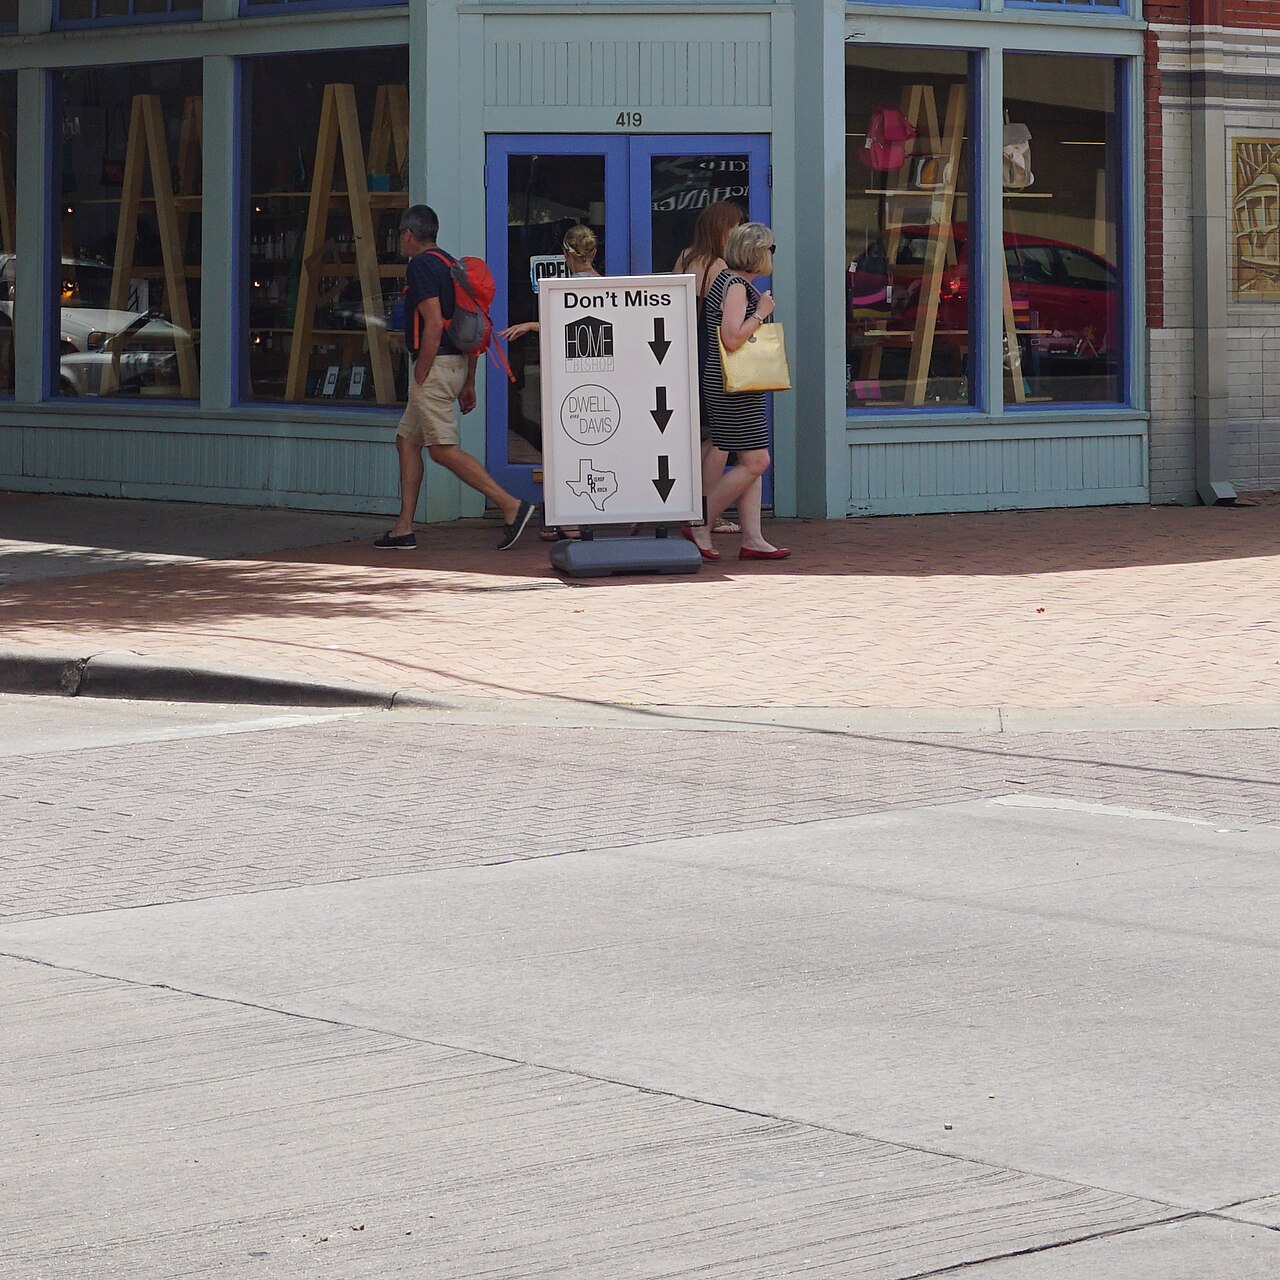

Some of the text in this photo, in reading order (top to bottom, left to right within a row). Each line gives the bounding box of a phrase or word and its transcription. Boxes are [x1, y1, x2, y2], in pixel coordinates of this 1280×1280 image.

[615, 111, 642, 127] 419
[564, 290, 672, 308] Don't Miss
[566, 324, 613, 358] HOME
[574, 358, 613, 373] BISHOP
[568, 396, 611, 413] DWELL
[580, 417, 612, 434] DAVIS
